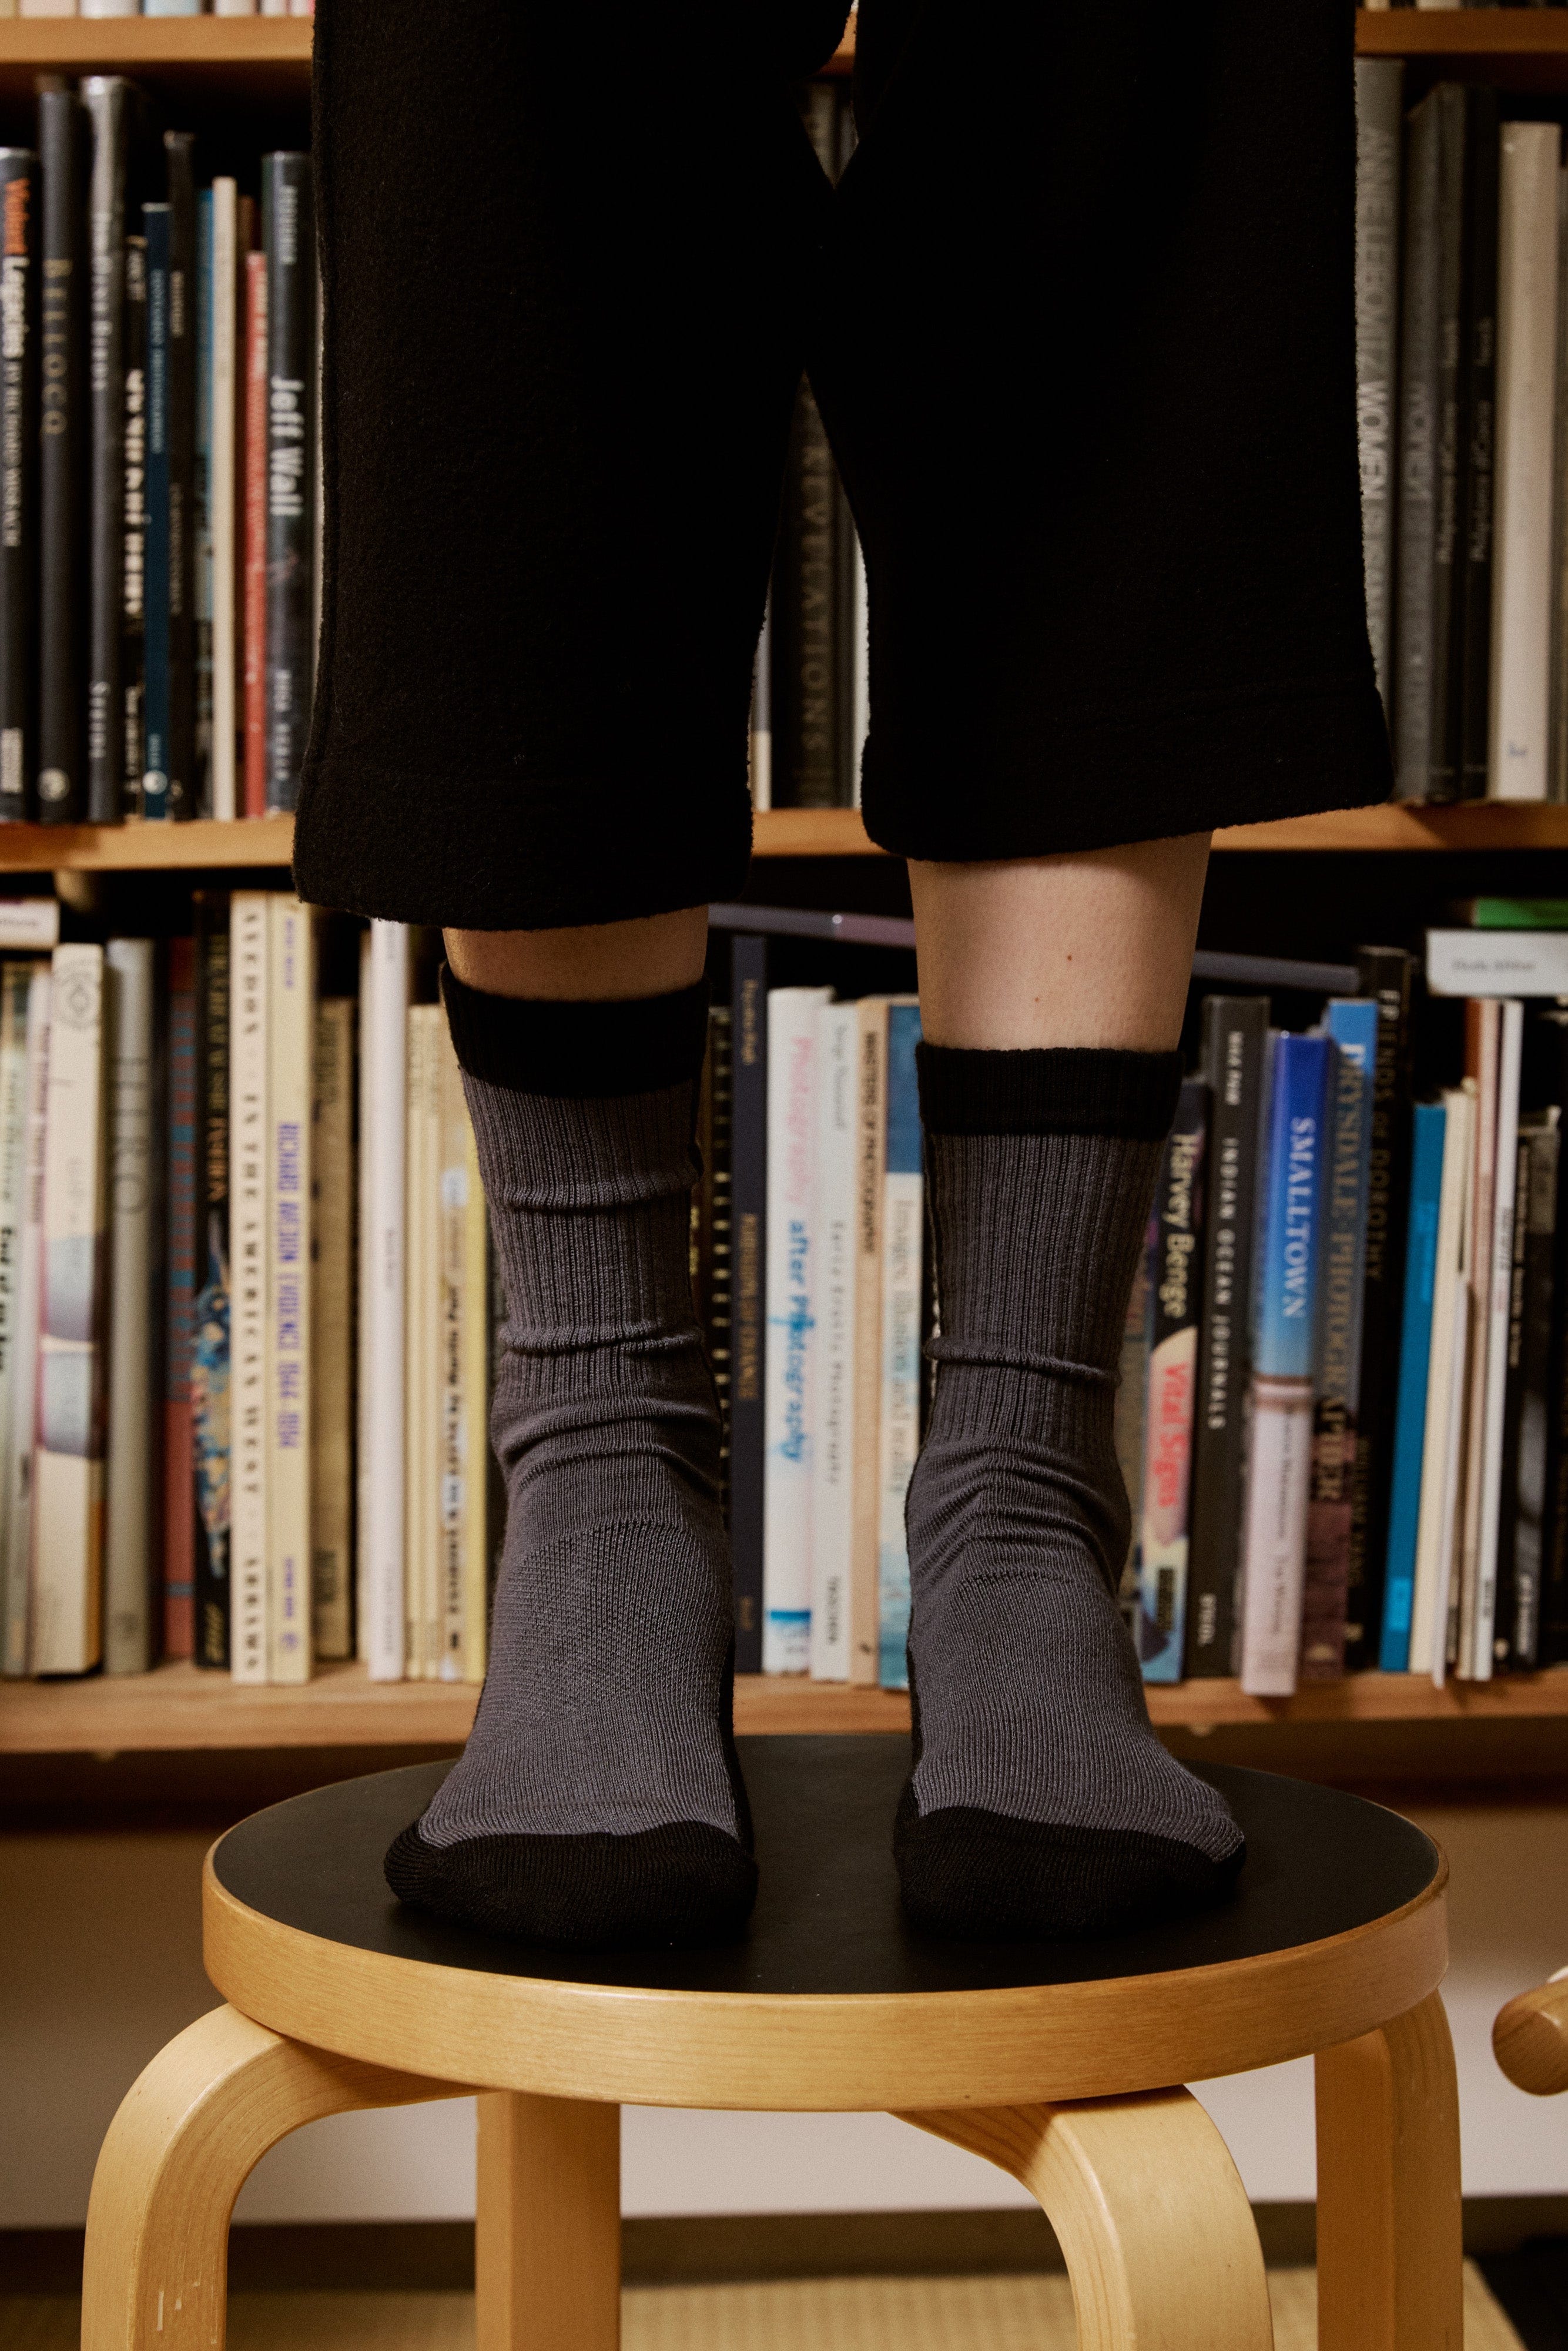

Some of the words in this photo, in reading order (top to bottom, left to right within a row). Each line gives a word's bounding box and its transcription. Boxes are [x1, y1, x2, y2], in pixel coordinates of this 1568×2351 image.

[4, 178, 32, 255] Violent
[0, 256, 32, 359] Legacies
[40, 259, 72, 436] BELLOCQ
[270, 376, 304, 439] Jeff
[1356, 380, 1389, 500] WOMEN
[269, 445, 303, 517] Wall
[800, 445, 833, 751] REVELATIONS
[1375, 990, 1401, 1101] FRIENDS
[277, 1123, 300, 1192] RICHARD
[785, 1036, 813, 1204] Photography
[1332, 1044, 1367, 1219] DRYSDALE
[1162, 1133, 1201, 1229] Harvey
[1219, 1137, 1239, 1219] INDIAN
[1281, 1117, 1316, 1318] SMALLTOWN
[1365, 1148, 1392, 1282] DOROTHY
[276, 1202, 300, 1264] AVEDON
[788, 1220, 810, 1286] after
[1158, 1234, 1196, 1318] Benge
[1215, 1228, 1236, 1305] OCEAN
[276, 1272, 301, 1351] EVIDENCE
[780, 1295, 812, 1463] Photography
[1161, 1361, 1189, 1425] Vital
[1208, 1315, 1231, 1429] JOURNALS
[1317, 1233, 1358, 1501] PHOTOGRAPHER
[1154, 1432, 1189, 1507] Signs
